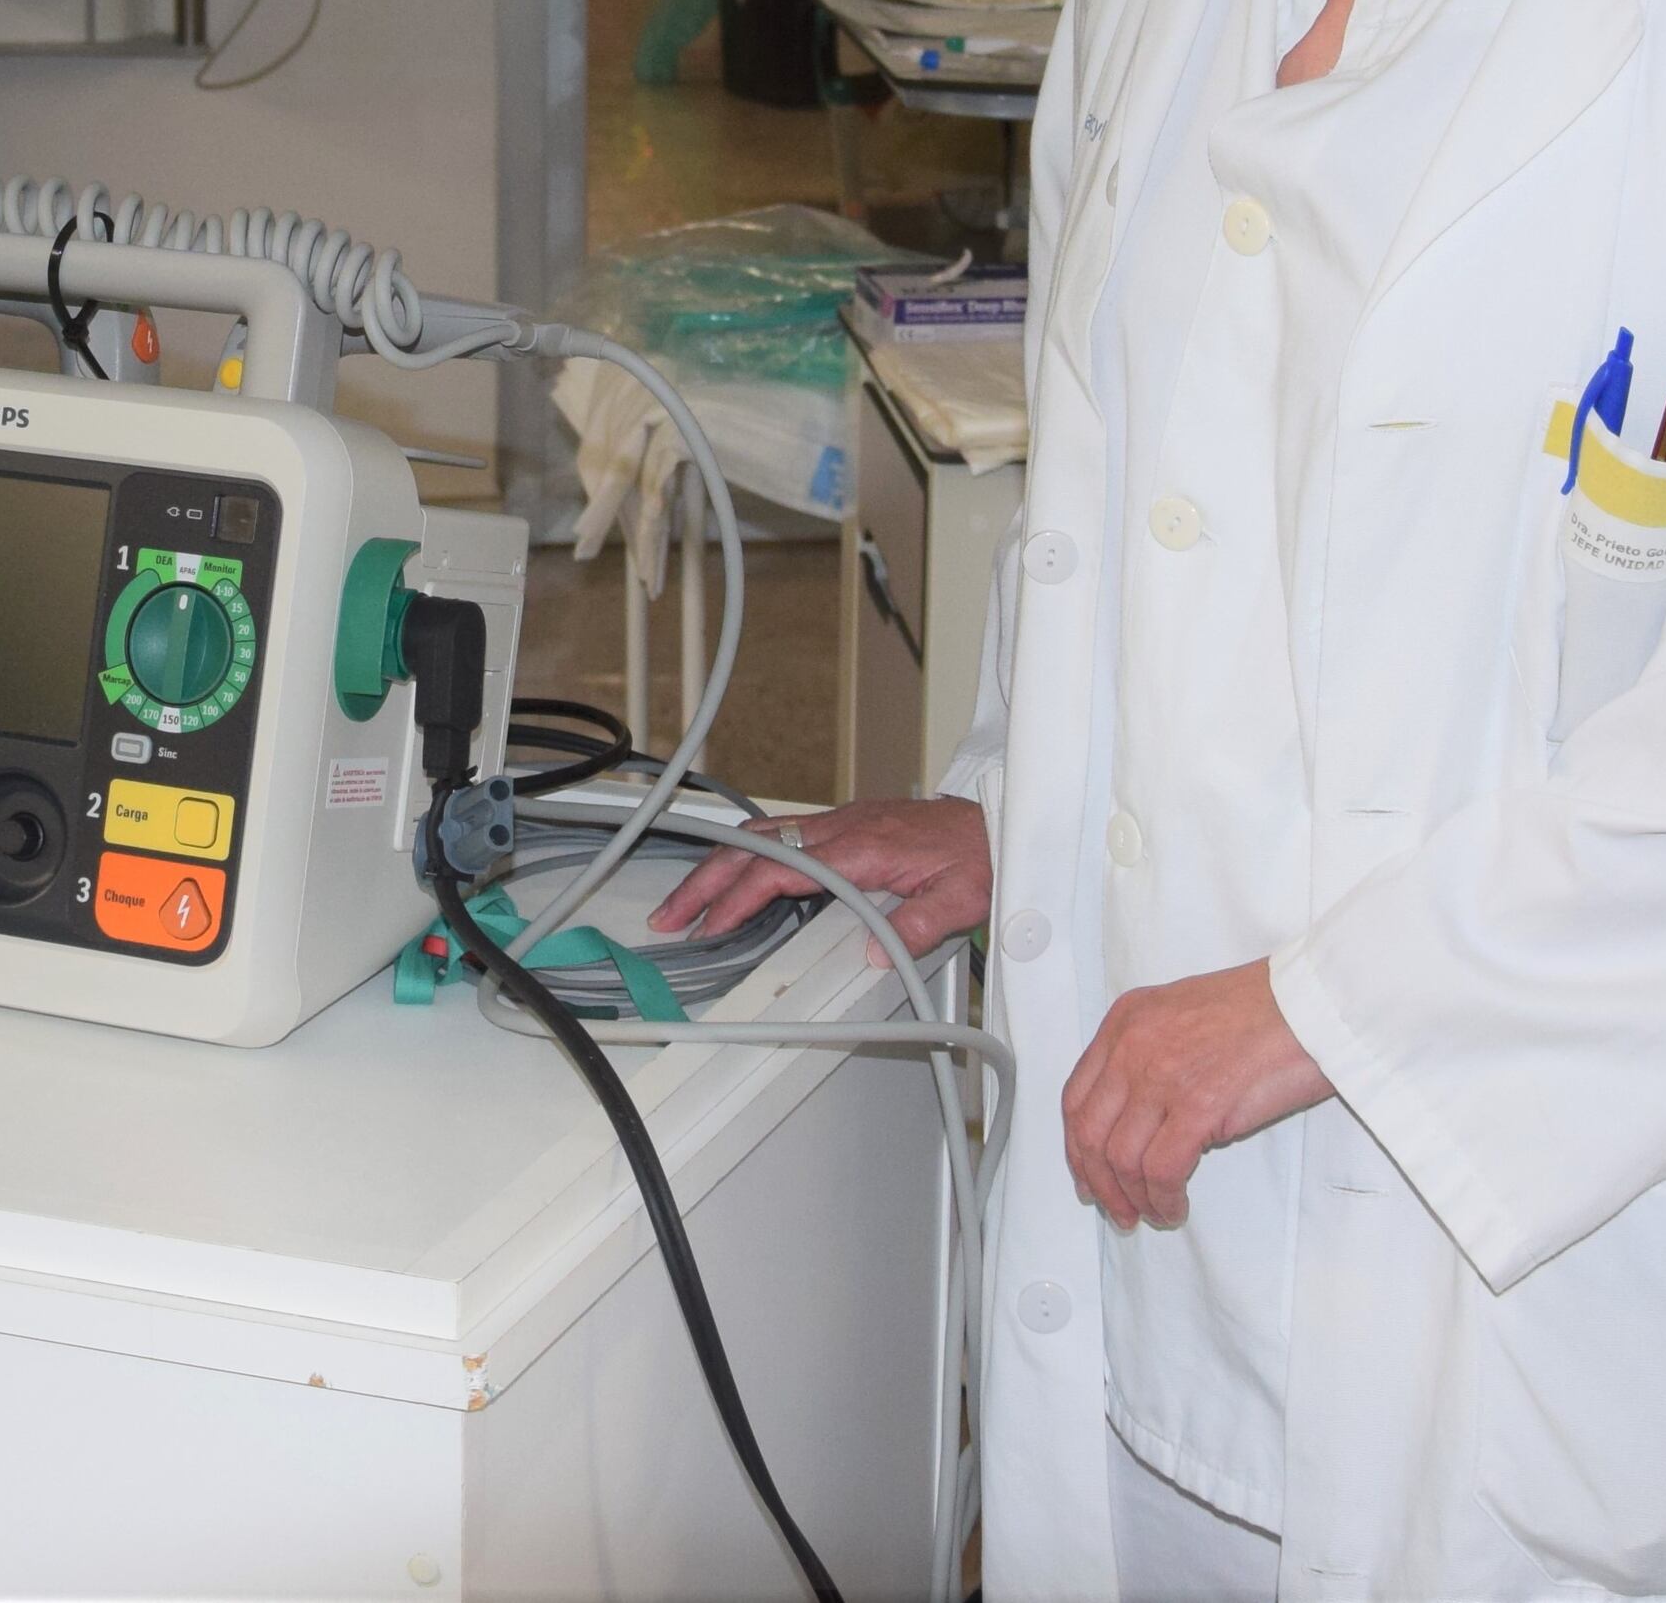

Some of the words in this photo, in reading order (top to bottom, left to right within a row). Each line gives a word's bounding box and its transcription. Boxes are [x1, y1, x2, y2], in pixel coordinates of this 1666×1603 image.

[1571, 512, 1591, 538] Dra.
[1596, 533, 1641, 557] Prieto
[116, 545, 130, 570] 1
[1571, 532, 1601, 559] JEFE
[1604, 553, 1665, 571] UNIDAD
[155, 554, 173, 566] DEA
[203, 561, 237, 575] Monitor
[215, 584, 234, 597] 1-10
[231, 602, 243, 613] 15
[238, 624, 250, 635] 20
[240, 648, 251, 659] 30
[234, 671, 246, 683] 50
[126, 693, 143, 706] 200
[222, 692, 234, 703] 70
[143, 708, 160, 720] 170
[202, 704, 219, 717] 100
[162, 714, 181, 726] 150
[182, 714, 199, 726] 120
[158, 747, 178, 759] Sinc
[86, 792, 102, 818] 2
[115, 803, 149, 822] Carga
[76, 877, 91, 903] 3
[104, 889, 146, 909] Choque
